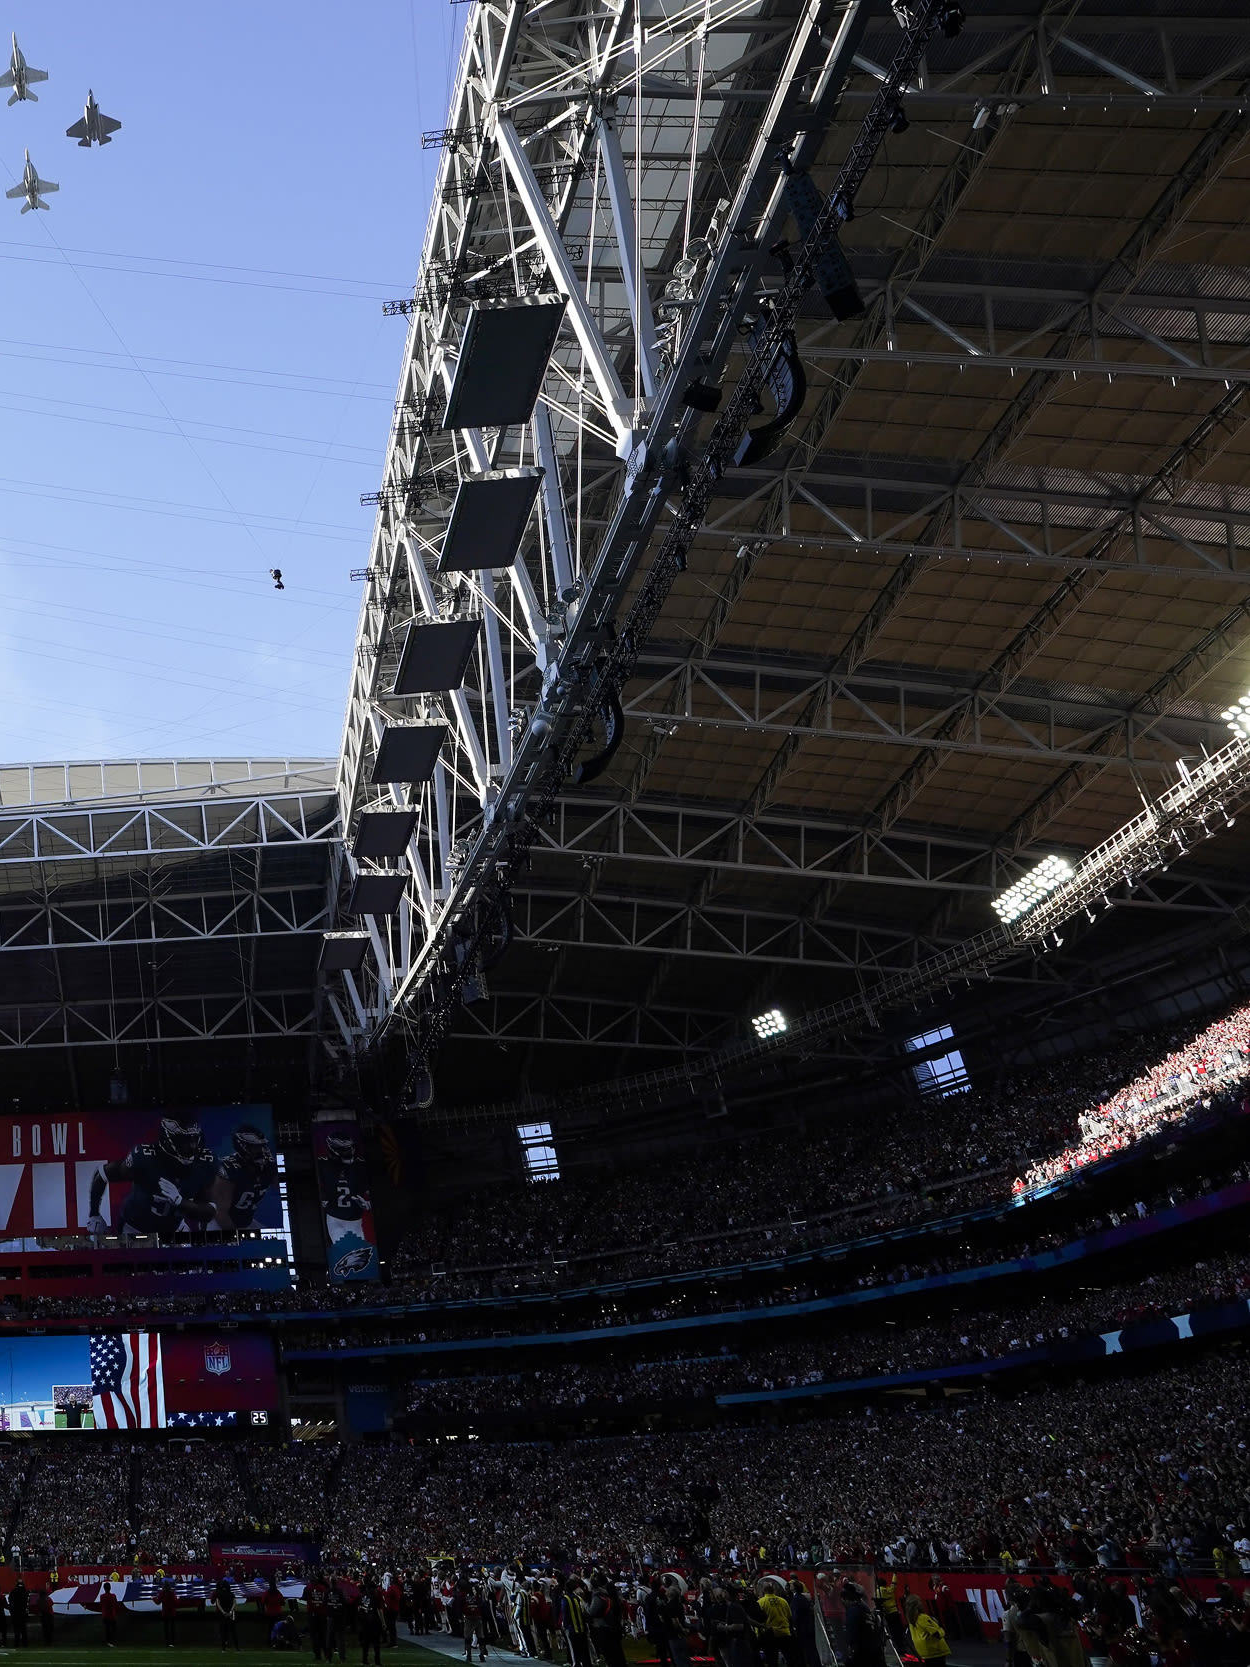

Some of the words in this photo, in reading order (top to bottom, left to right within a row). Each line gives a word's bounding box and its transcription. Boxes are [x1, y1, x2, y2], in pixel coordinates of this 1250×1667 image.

[13, 1122, 86, 1158] BOWL
[336, 1186, 351, 1208] 2
[206, 1356, 227, 1370] NFL
[349, 1384, 388, 1393] verizon
[253, 1412, 266, 1424] 25
